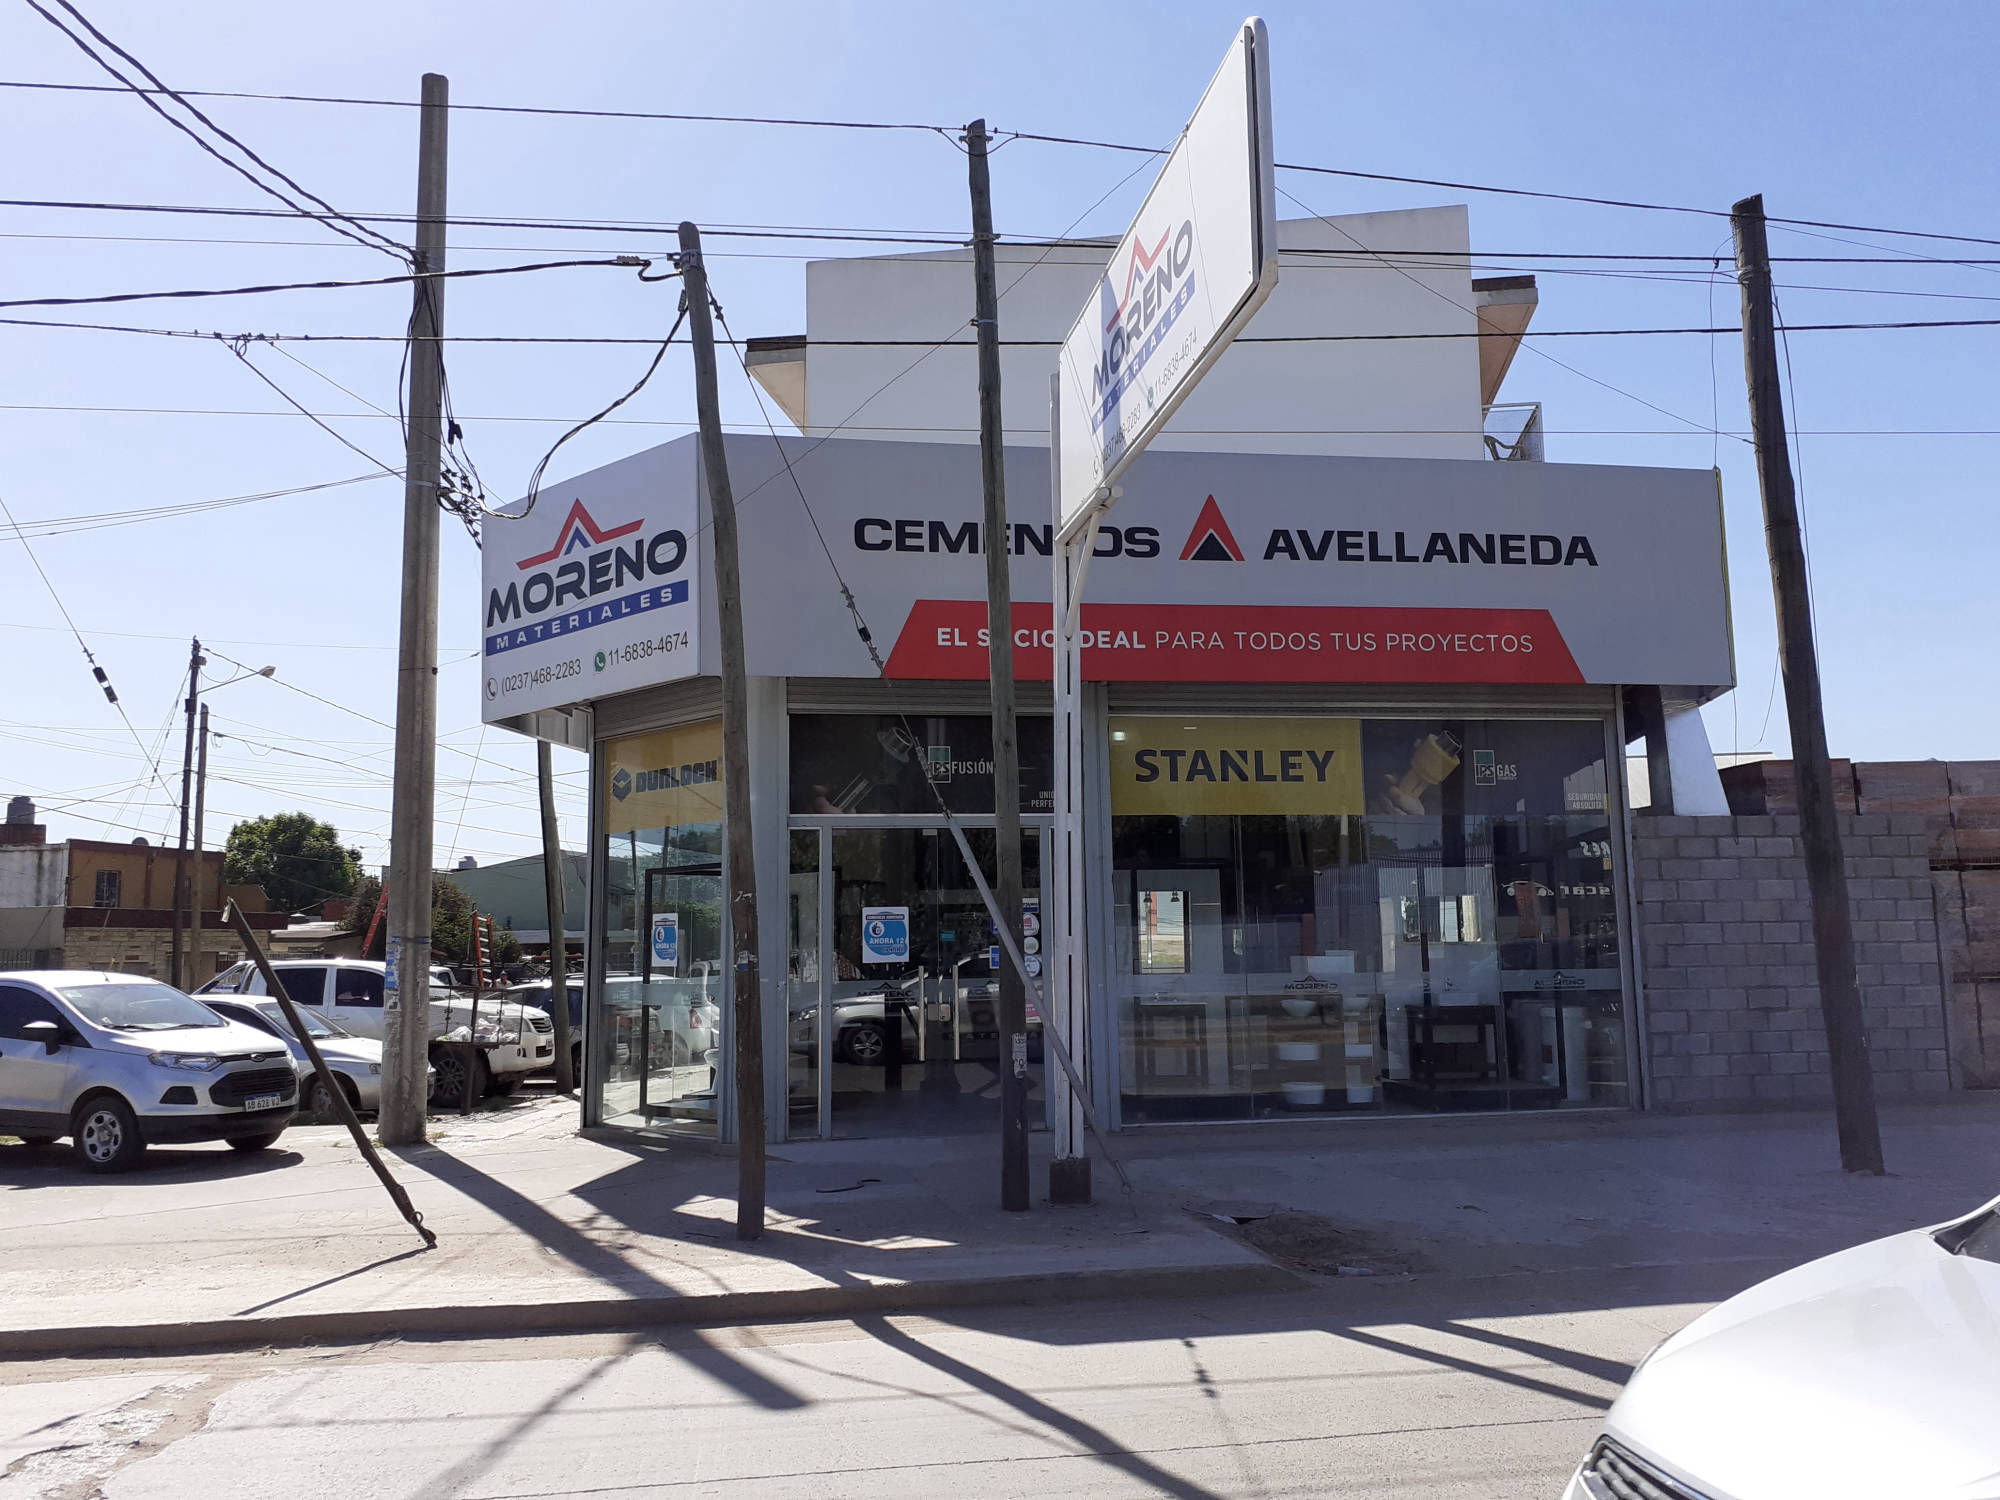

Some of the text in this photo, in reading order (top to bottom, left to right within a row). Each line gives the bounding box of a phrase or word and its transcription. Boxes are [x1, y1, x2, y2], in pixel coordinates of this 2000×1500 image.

[1092, 219, 1192, 407] MORENO
[1096, 290, 1188, 425] MATERIALES
[854, 518, 1599, 567] CEMNOS AVELLANEDA
[487, 529, 687, 628] MORENO
[496, 587, 673, 650] MATERIALES
[608, 631, 688, 666] 11-6838-4674
[937, 627, 1534, 653] EL SCIO DEAL PARA TODOS TUS PROYECTOS
[501, 658, 581, 696] (0237)468-2283
[952, 758, 994, 775] FUSIÓN
[1134, 748, 1335, 783] STANLEY
[1496, 764, 1517, 777] GAS
[1568, 792, 1602, 801] SEGURIDAD
